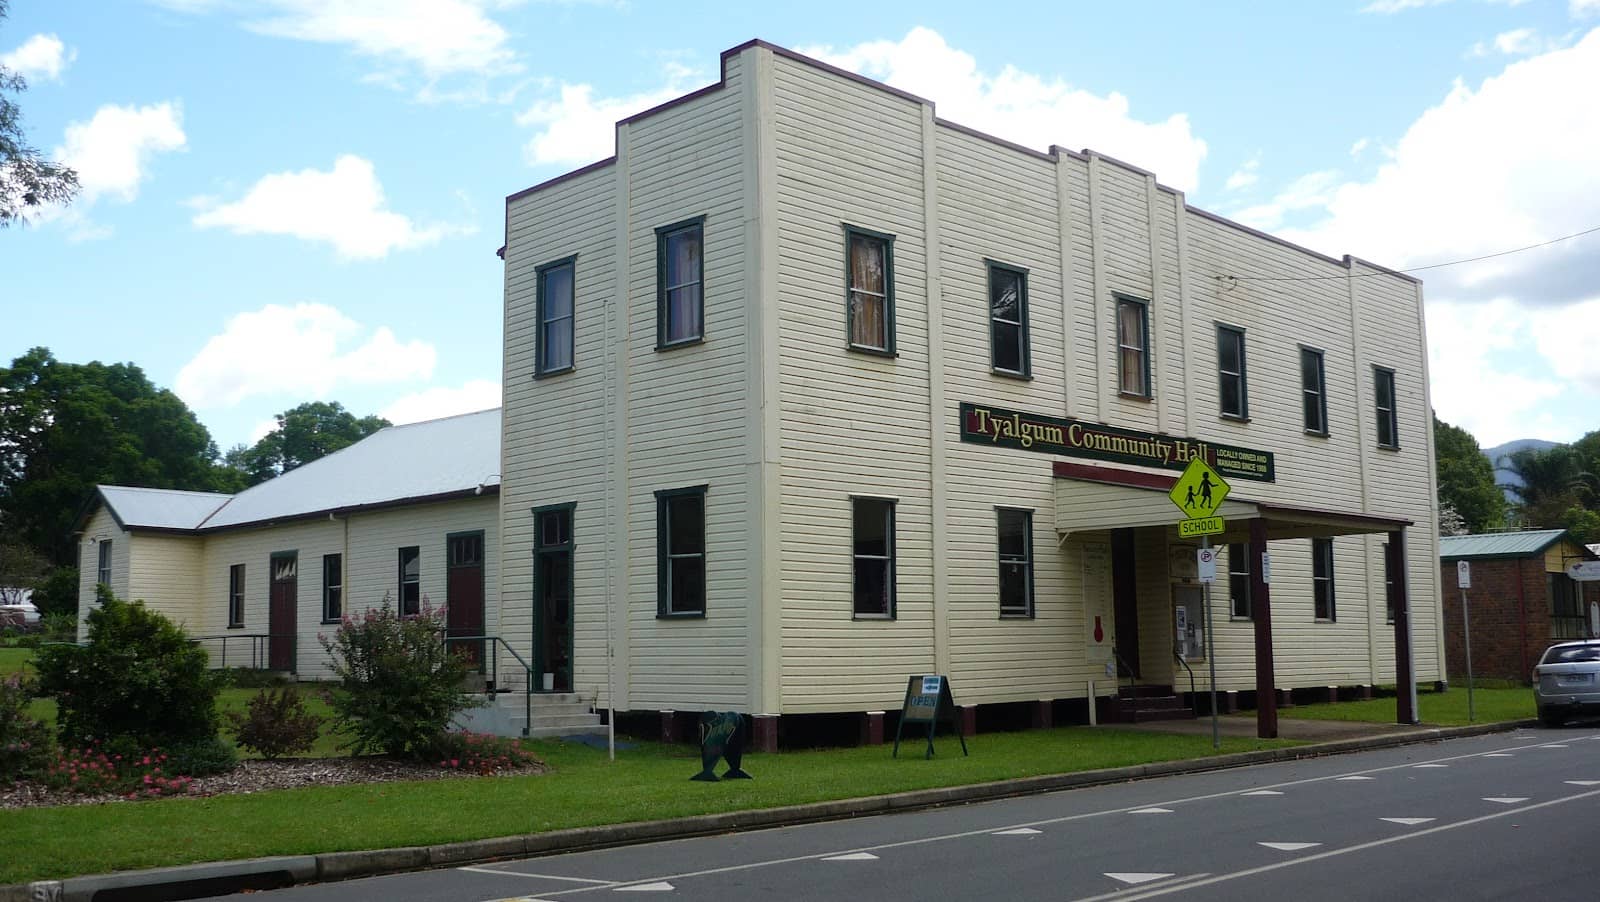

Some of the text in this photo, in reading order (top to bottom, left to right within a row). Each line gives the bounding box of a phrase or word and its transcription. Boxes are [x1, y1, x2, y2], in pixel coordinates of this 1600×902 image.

[974, 407, 1208, 465] Tyalgum Community Hall
[1217, 449, 1238, 458] LOCALLY
[1257, 455, 1267, 464] AND
[1217, 459, 1241, 469] MANAGED
[1183, 519, 1219, 533] SCHOOL
